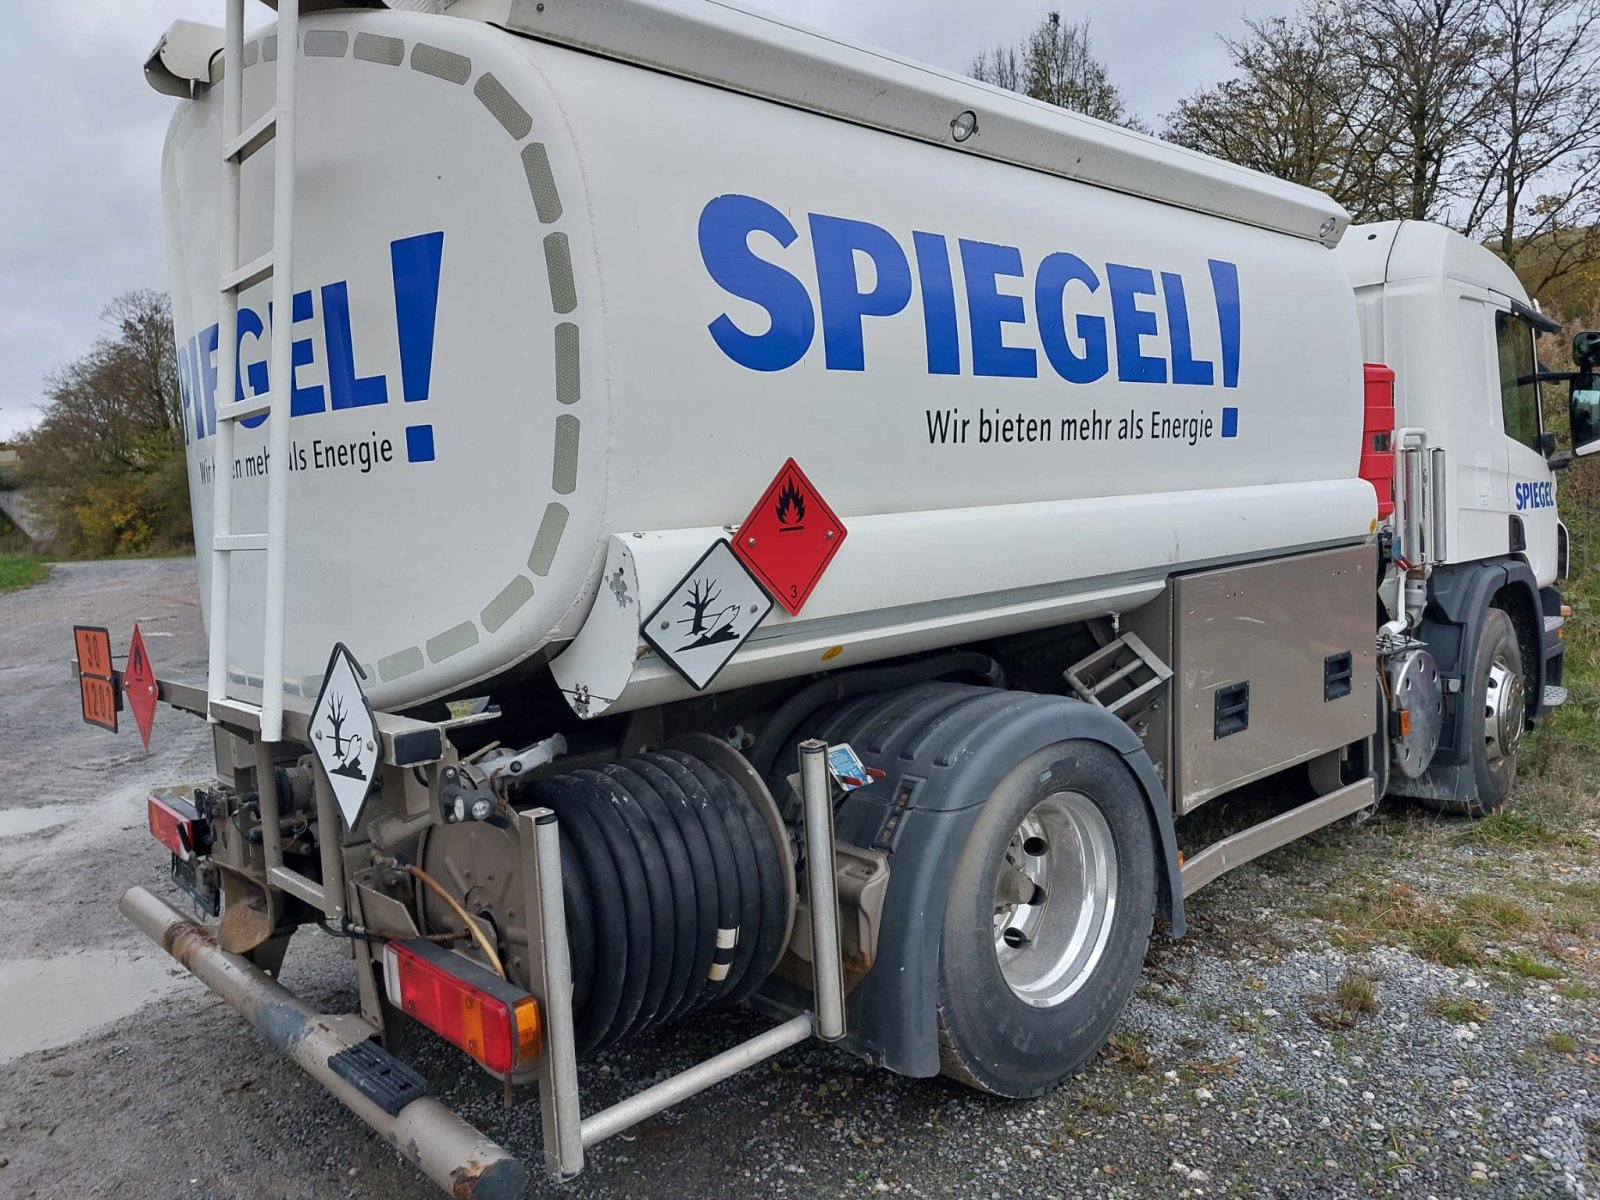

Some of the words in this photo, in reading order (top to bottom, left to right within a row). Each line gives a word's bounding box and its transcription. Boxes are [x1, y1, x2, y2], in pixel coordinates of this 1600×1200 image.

[697, 193, 1241, 438] SPIEGEL!
[177, 231, 444, 463] PIEGEL!
[926, 408, 970, 444] Wir
[978, 408, 1052, 443] bieten
[1060, 409, 1112, 441] mehr
[1117, 409, 1144, 440] als
[1150, 410, 1213, 446] Energie
[245, 445, 270, 477] meh
[312, 431, 394, 473] Energie
[1515, 481, 1554, 510] SPIEGEL
[790, 584, 798, 599] 3
[85, 633, 100, 669] 30
[85, 681, 113, 721] 1202
